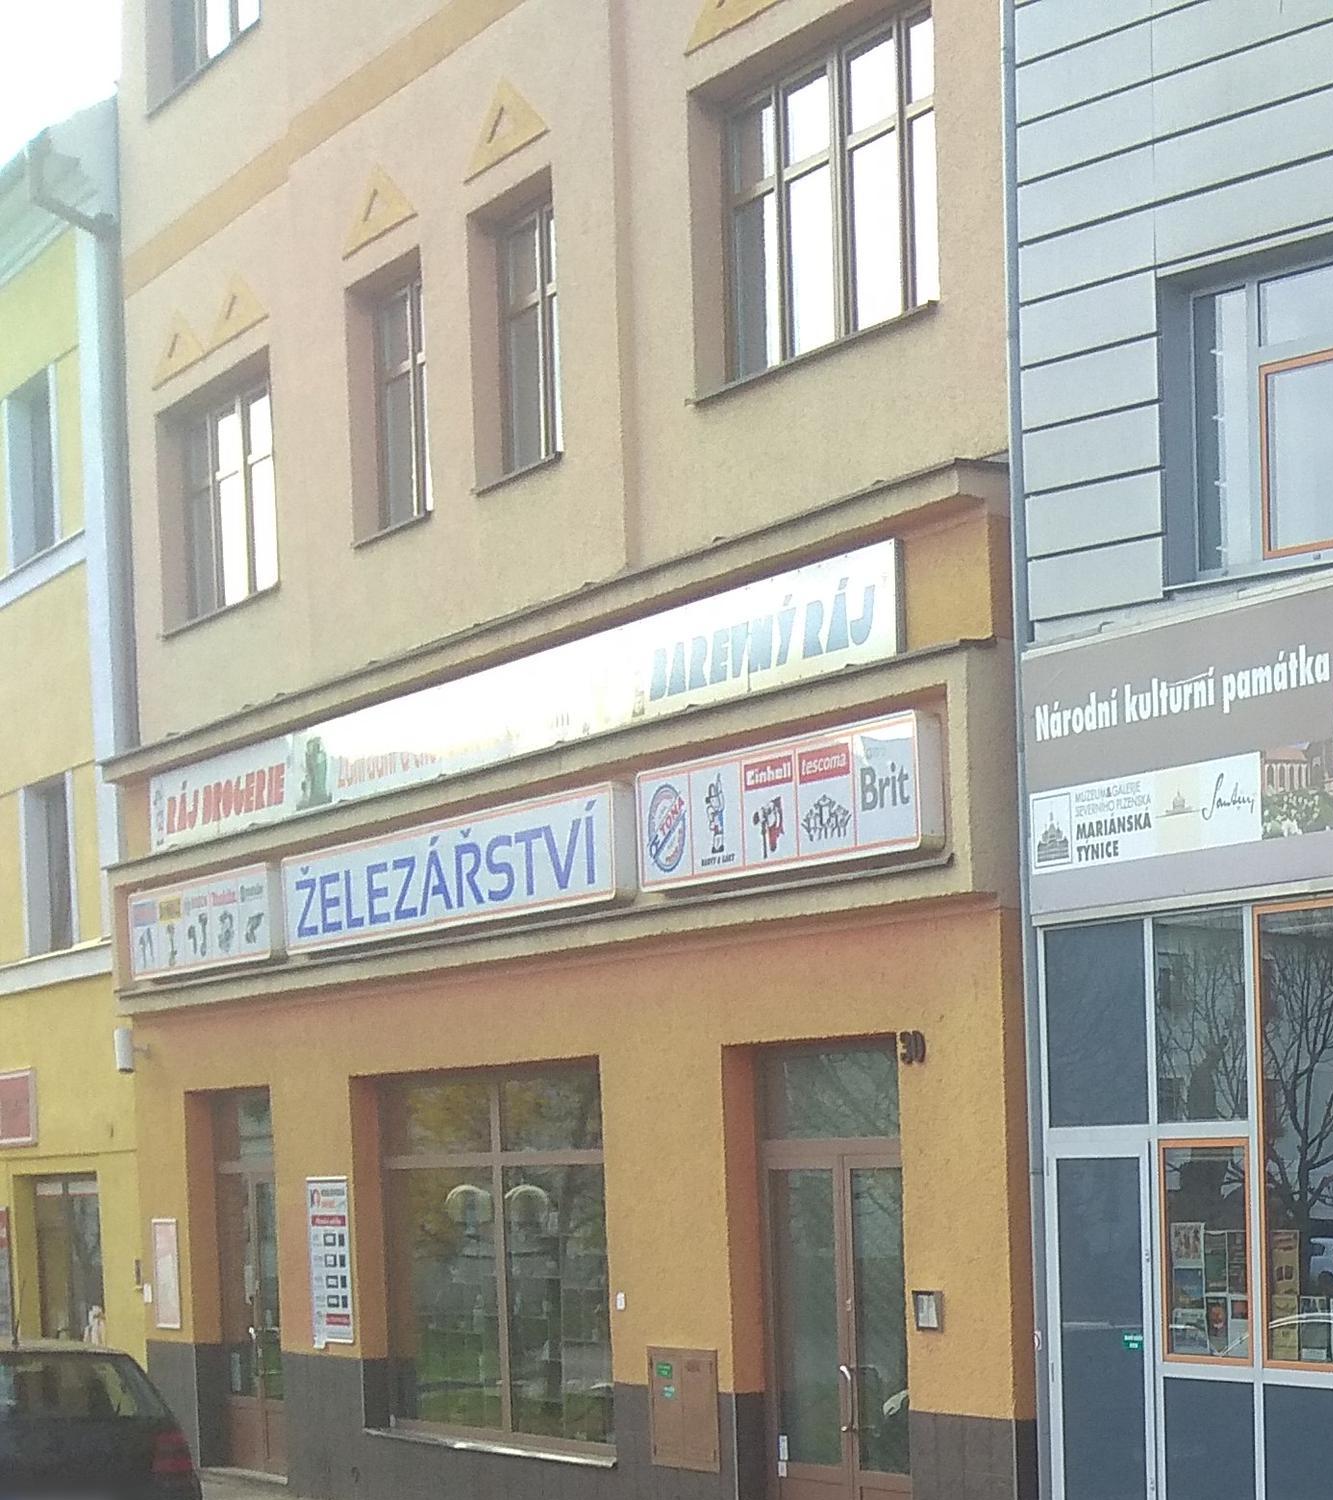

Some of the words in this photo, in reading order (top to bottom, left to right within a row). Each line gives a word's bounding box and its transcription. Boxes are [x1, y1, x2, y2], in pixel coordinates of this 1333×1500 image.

[649, 594, 797, 701] BAREVNÝ
[802, 577, 875, 659] RÁJ
[1035, 687, 1118, 742] Národní
[1125, 666, 1215, 723] kulturní
[1222, 645, 1331, 714] památka
[745, 761, 792, 786] Einhell
[800, 752, 846, 775] tescoma
[860, 762, 911, 812] Brit
[166, 780, 199, 835] RÁJ
[201, 762, 286, 825] DROGERIE
[1076, 807, 1152, 841] MARIÁNSKÁ
[295, 799, 597, 938] ŽELEZÁŘSTVÍ
[1076, 840, 1120, 863] TÝNICE
